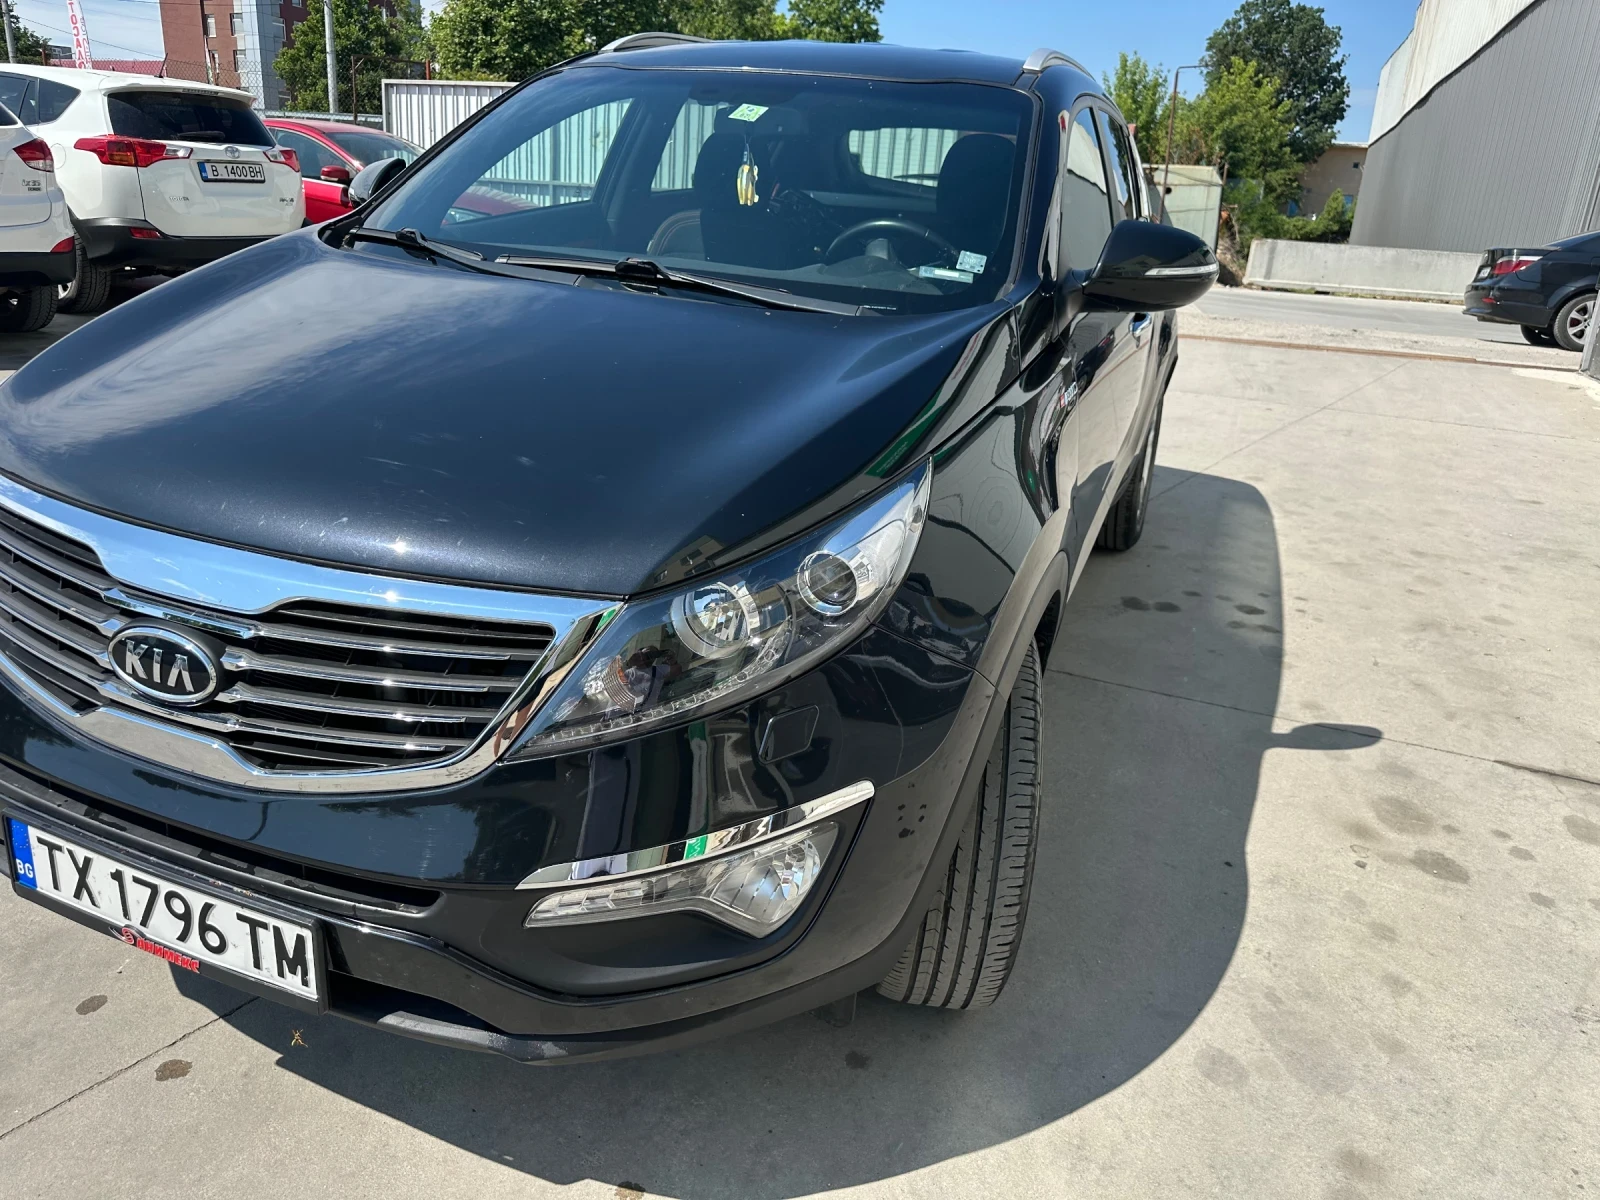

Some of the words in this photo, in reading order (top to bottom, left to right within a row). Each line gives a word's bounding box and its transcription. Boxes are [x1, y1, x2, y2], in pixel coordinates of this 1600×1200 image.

[224, 165, 248, 178] 1400
[248, 166, 262, 179] BH
[125, 639, 195, 693] KIA
[16, 858, 35, 879] BG
[36, 836, 101, 909] TX
[109, 868, 229, 955] 1796
[236, 912, 310, 988] TM
